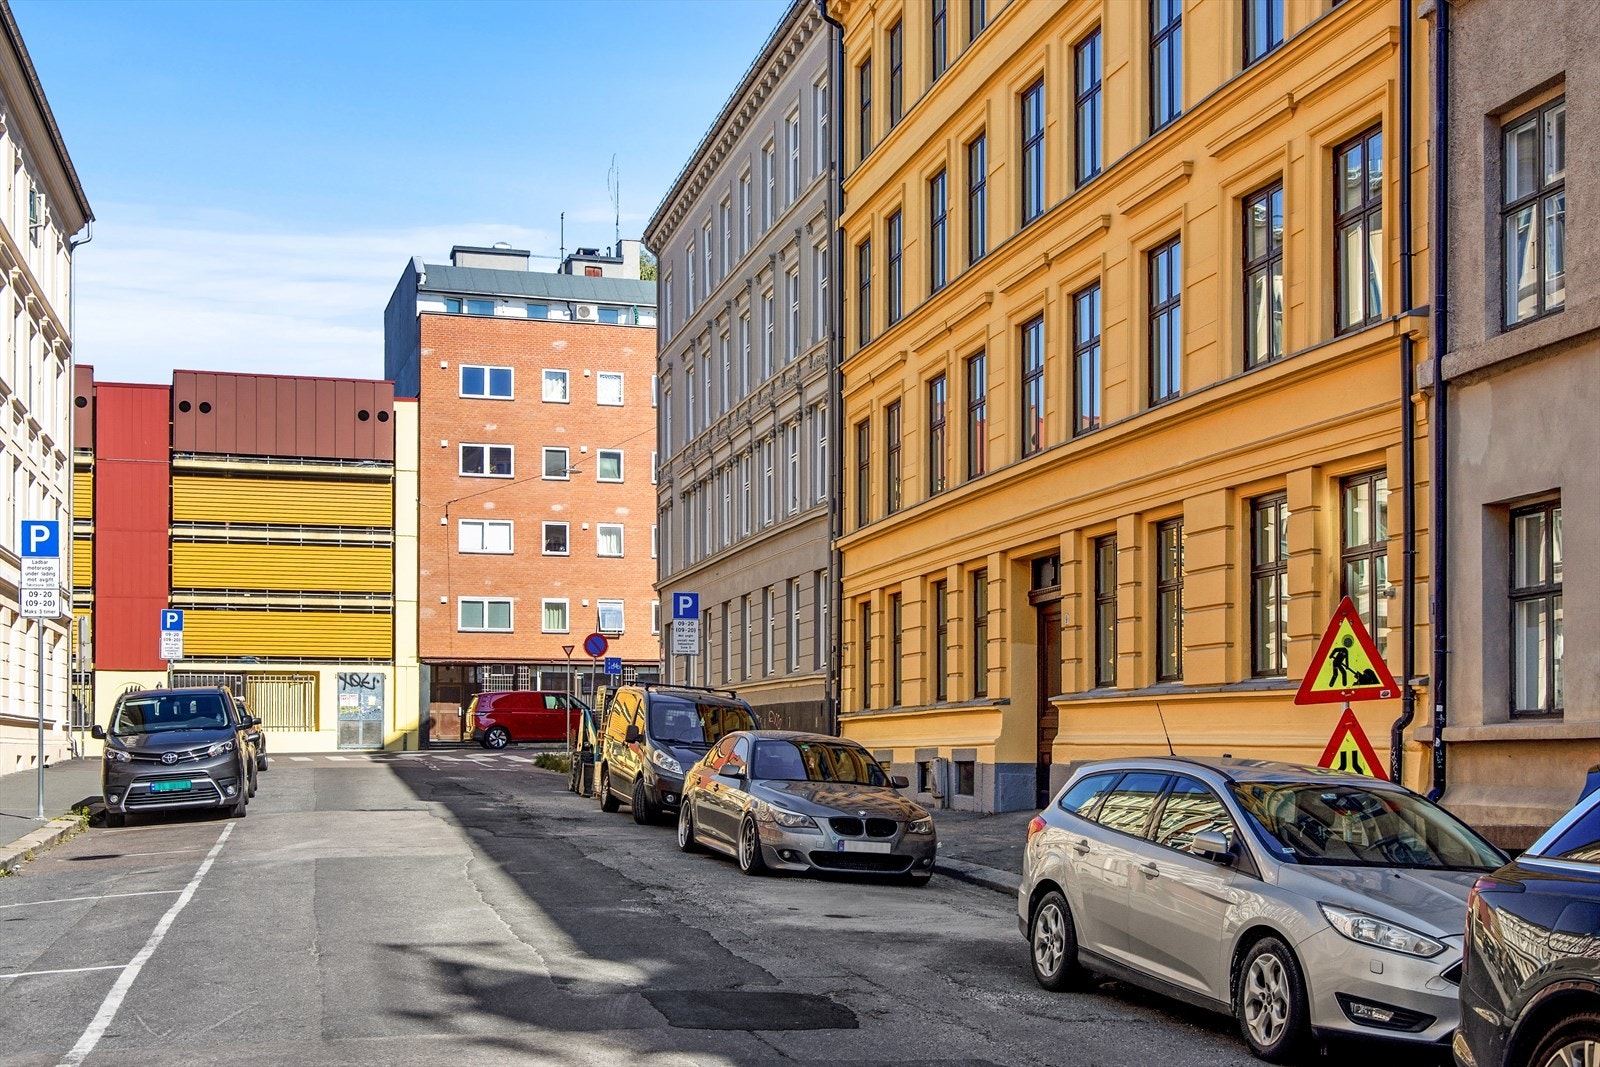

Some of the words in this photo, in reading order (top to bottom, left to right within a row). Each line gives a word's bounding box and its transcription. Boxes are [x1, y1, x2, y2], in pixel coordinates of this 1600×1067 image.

[30, 525, 50, 552] P
[679, 596, 692, 616] P
[166, 612, 178, 628] P
